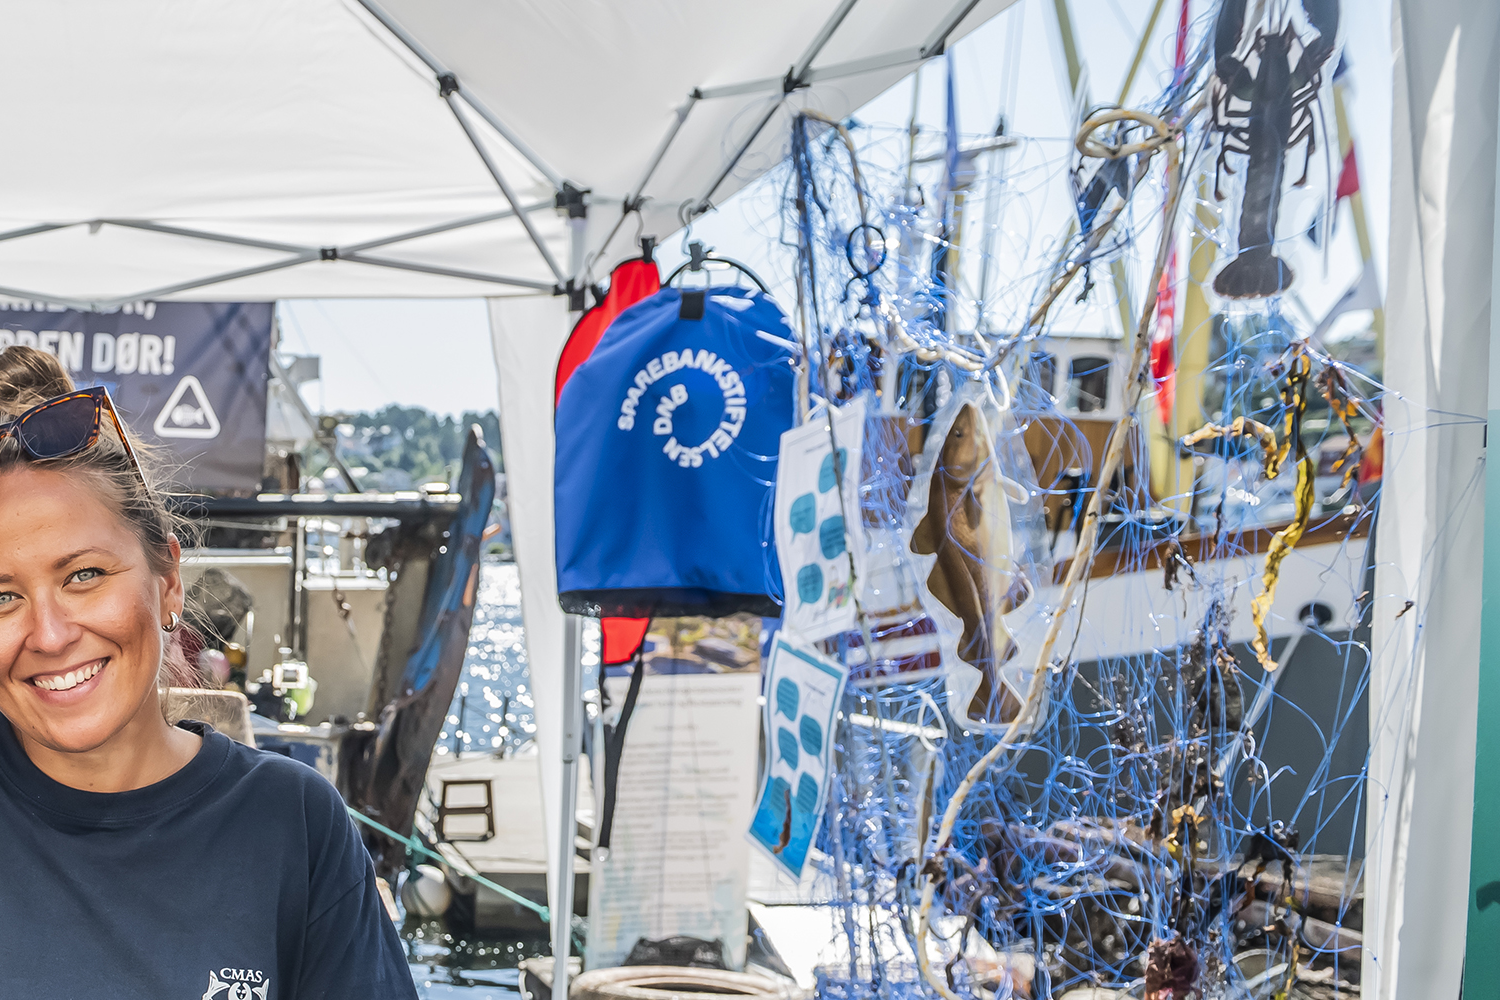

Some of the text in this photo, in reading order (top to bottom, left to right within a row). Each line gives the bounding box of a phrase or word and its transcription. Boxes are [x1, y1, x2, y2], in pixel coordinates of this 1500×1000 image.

[91, 332, 176, 376] DØR!
[617, 348, 747, 468] SPAREBANKSTIFTELSEN DNB
[219, 967, 263, 983] CMAS
